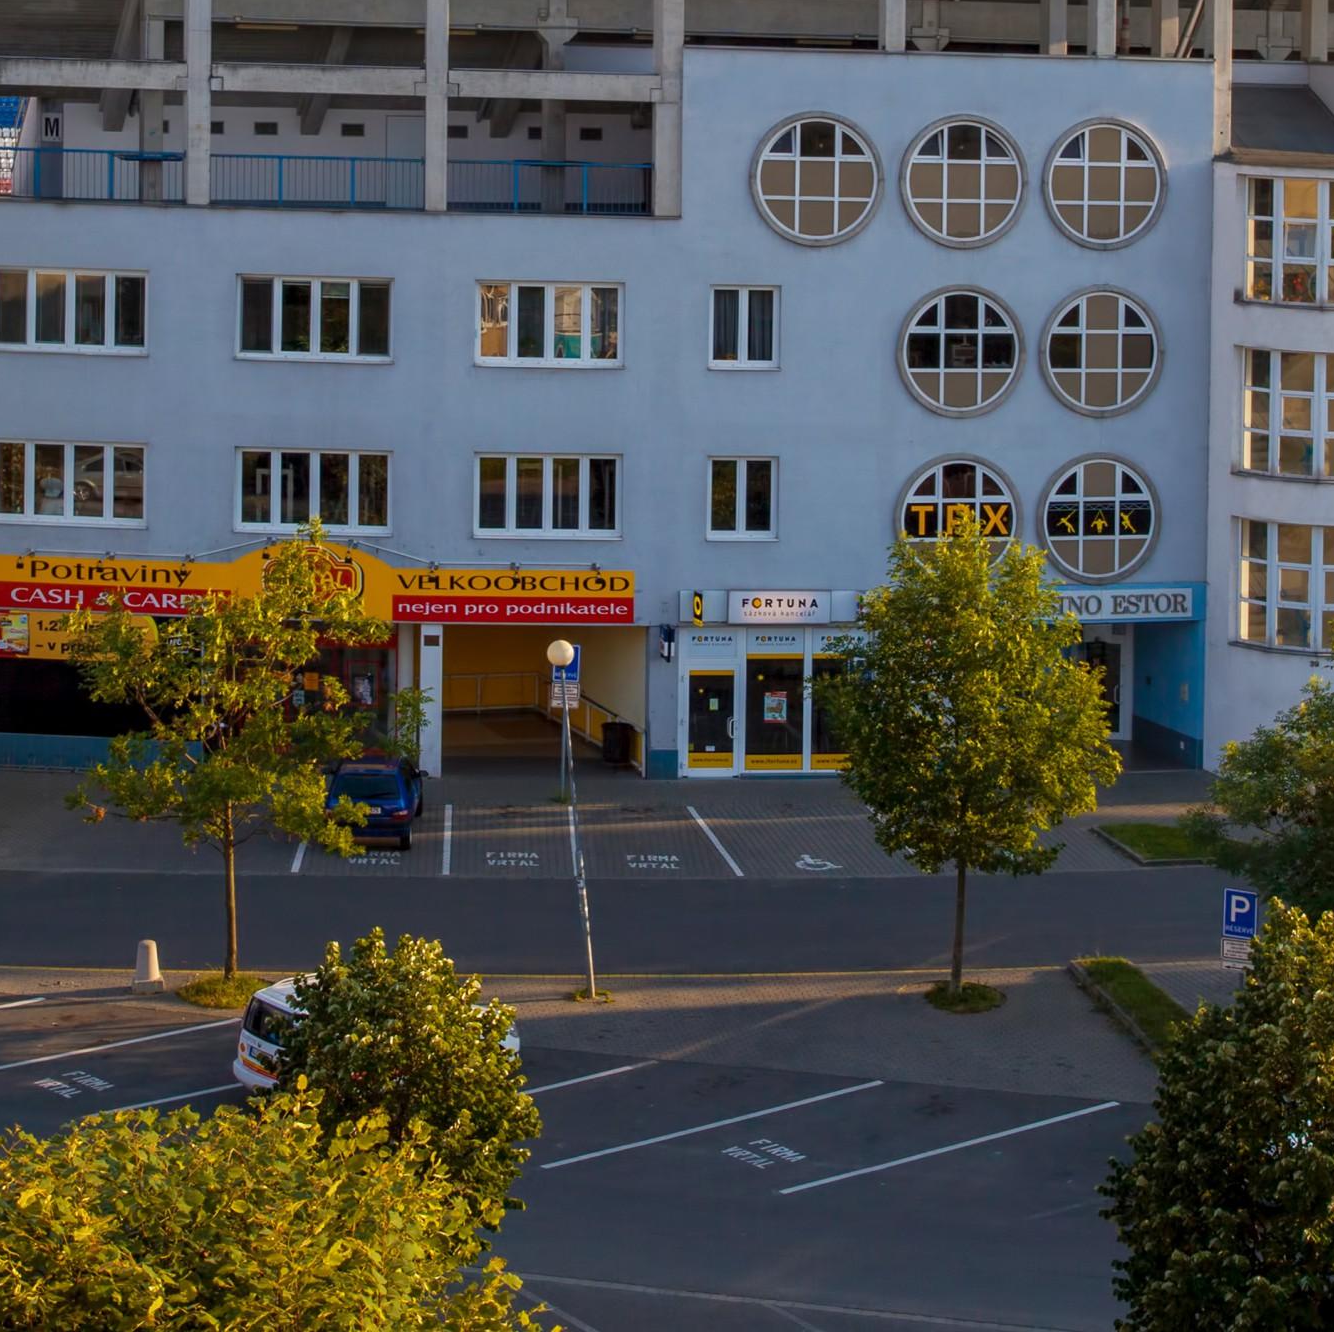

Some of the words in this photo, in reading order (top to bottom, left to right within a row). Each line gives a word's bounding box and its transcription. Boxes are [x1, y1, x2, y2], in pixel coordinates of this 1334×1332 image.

[44, 117, 59, 137] M
[30, 560, 192, 587] Potraviny
[397, 574, 630, 592] VELKOOBCHOD
[10, 587, 84, 605] CASH
[741, 597, 819, 609] FORTUNA
[1110, 593, 1188, 616] ESTOR
[398, 602, 457, 616] nejen
[464, 602, 499, 617] pro
[506, 601, 629, 617] podnikatele
[691, 635, 733, 643] FORTUNA
[755, 635, 796, 643] FORTUNA
[1230, 894, 1251, 923] P
